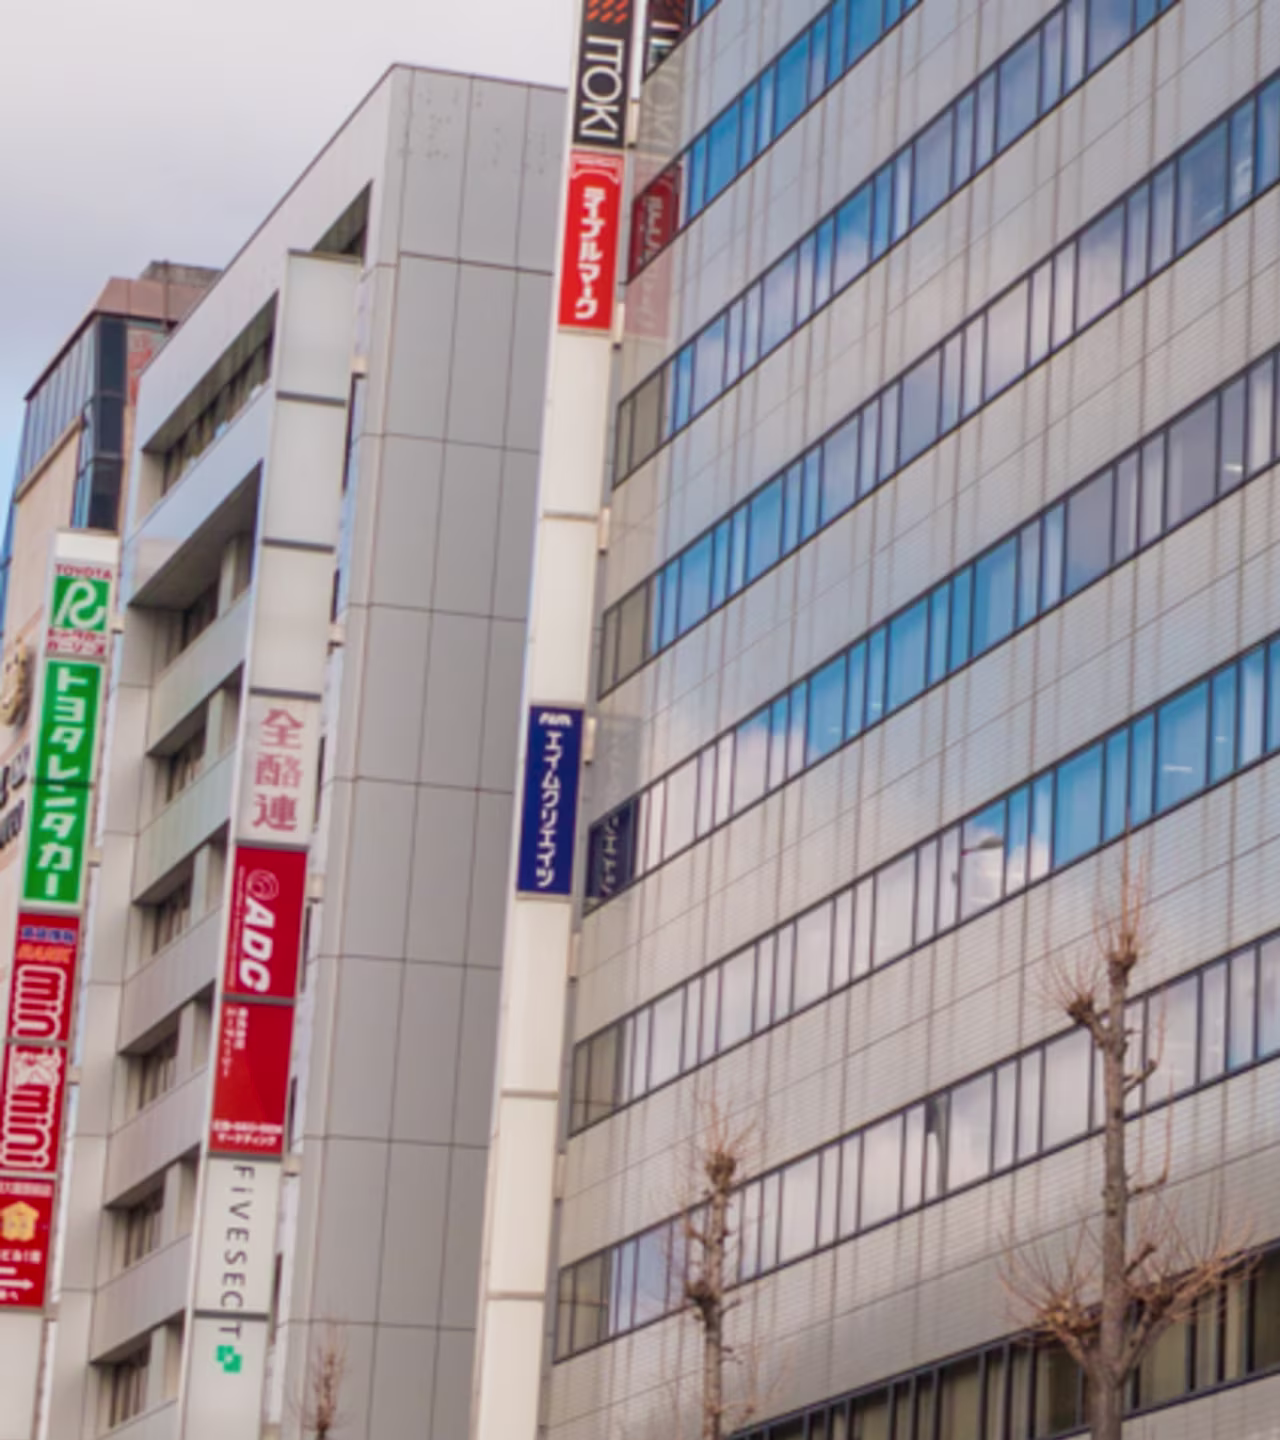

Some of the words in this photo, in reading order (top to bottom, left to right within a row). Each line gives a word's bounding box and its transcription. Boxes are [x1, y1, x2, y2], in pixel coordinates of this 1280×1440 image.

[580, 35, 624, 139] ITOKI
[55, 563, 112, 579] TOYOTA
[36, 667, 88, 897] トヨタレンタカー
[252, 708, 304, 832] 全酪連
[536, 730, 563, 889] エイムクリエイツ
[238, 896, 276, 993] ADC
